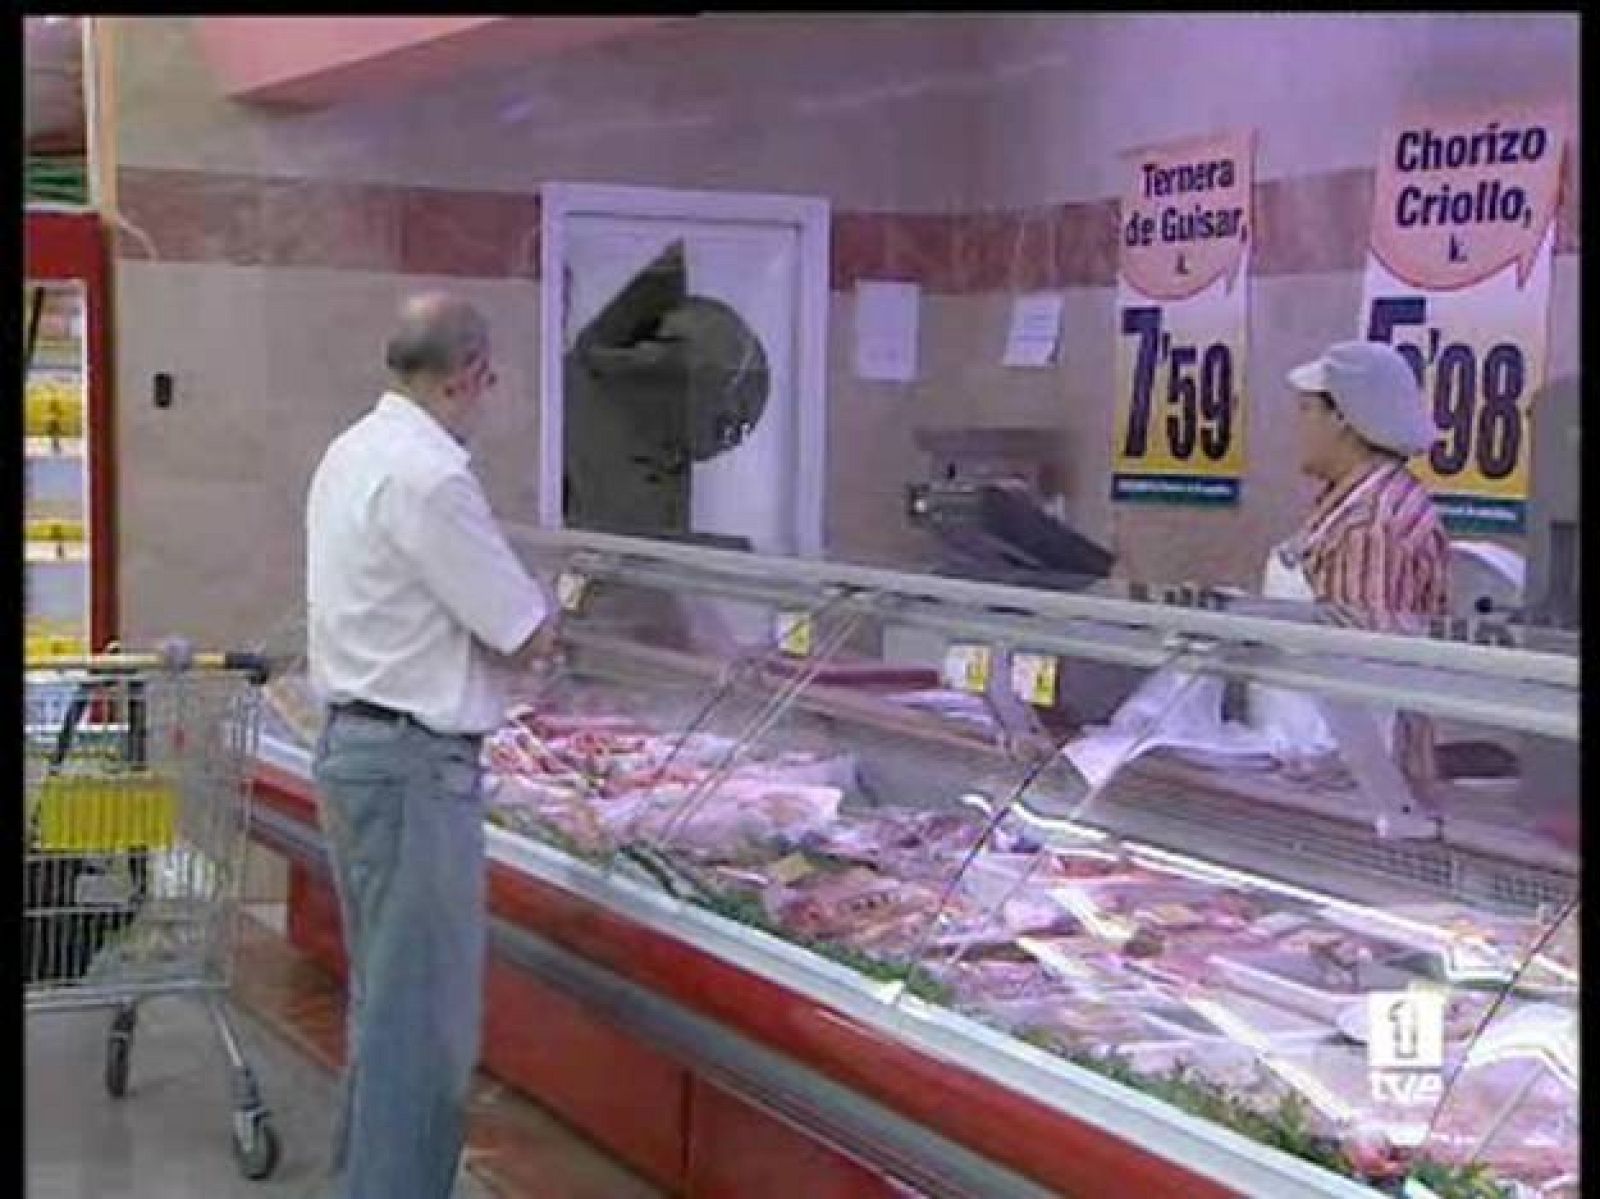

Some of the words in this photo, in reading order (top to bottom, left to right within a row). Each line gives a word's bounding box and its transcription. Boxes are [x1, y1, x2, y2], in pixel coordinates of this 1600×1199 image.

[1397, 122, 1546, 172] Chorizo
[1142, 159, 1235, 198] Ternera
[1125, 211, 1154, 247] de
[1161, 203, 1248, 244] Guisar,
[1397, 180, 1532, 229] Criollo,
[1121, 306, 1232, 461] 7'59
